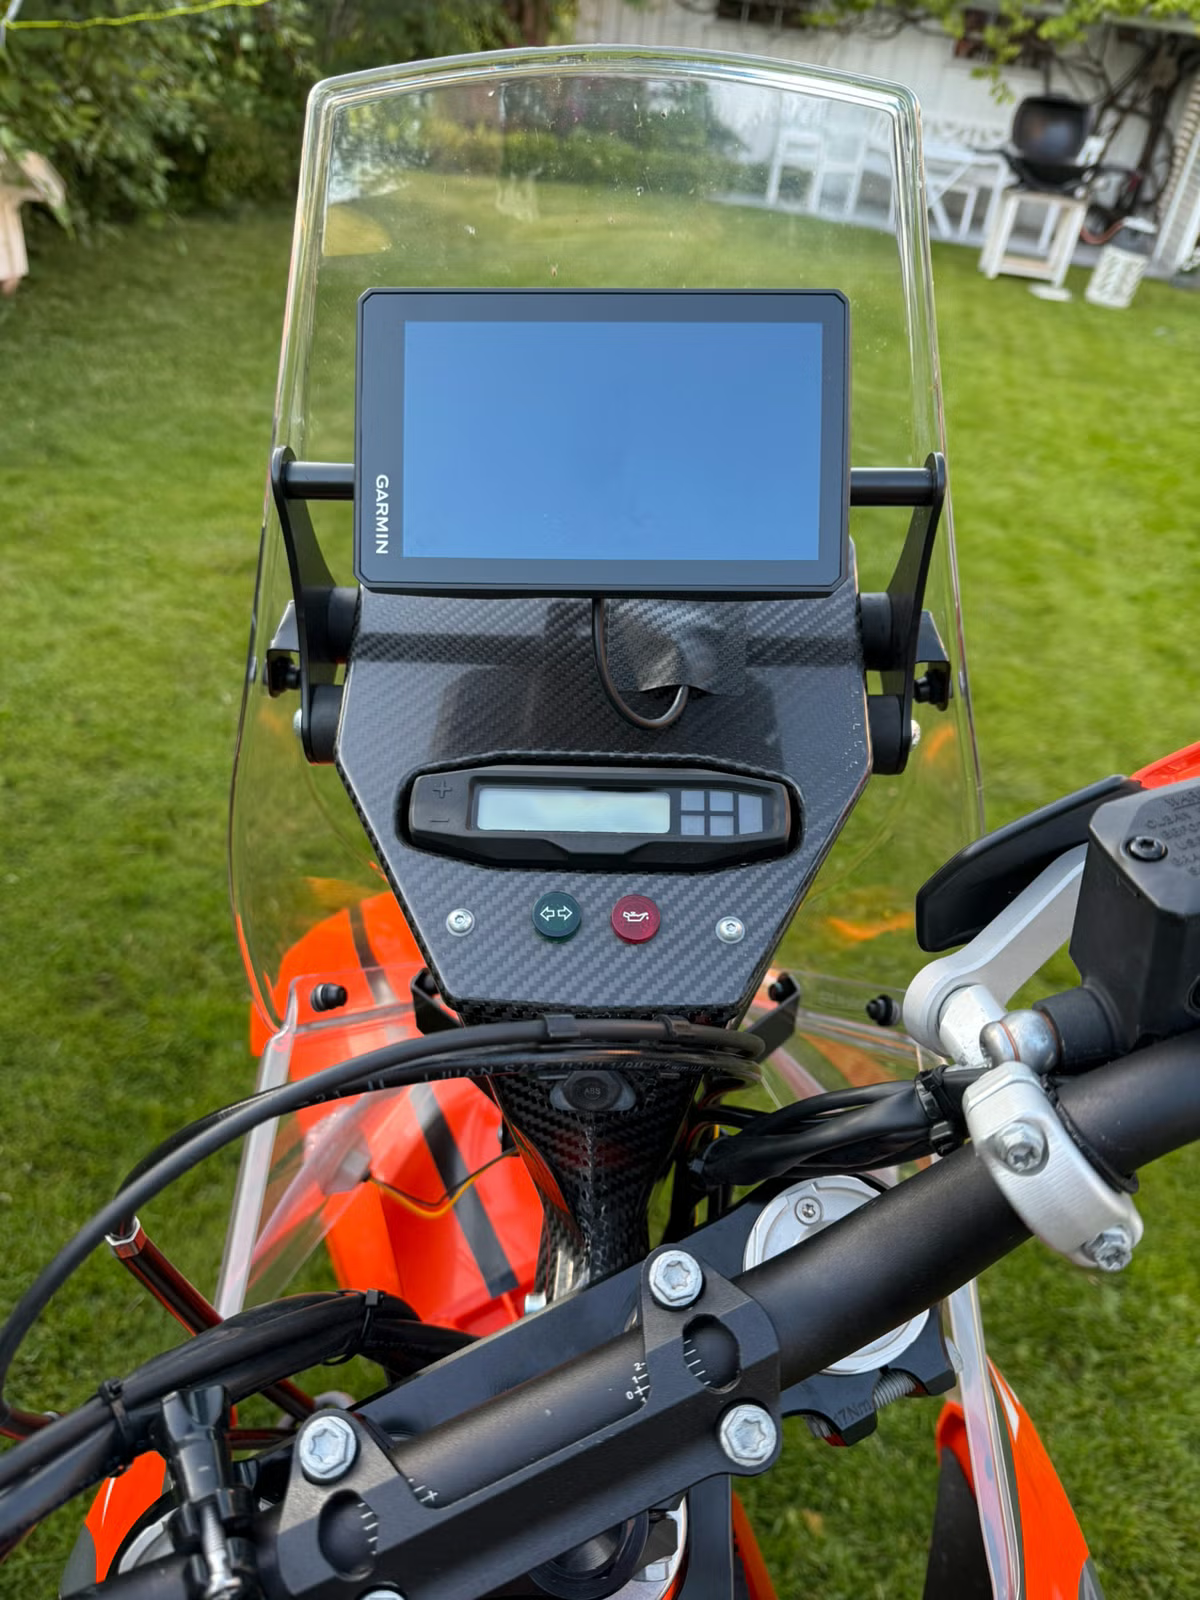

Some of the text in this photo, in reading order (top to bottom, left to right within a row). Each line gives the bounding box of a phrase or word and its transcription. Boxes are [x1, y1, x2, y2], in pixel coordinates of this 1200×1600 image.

[375, 474, 390, 554] GARMIN
[583, 1087, 601, 1096] ABS
[633, 1362, 643, 1372] 2
